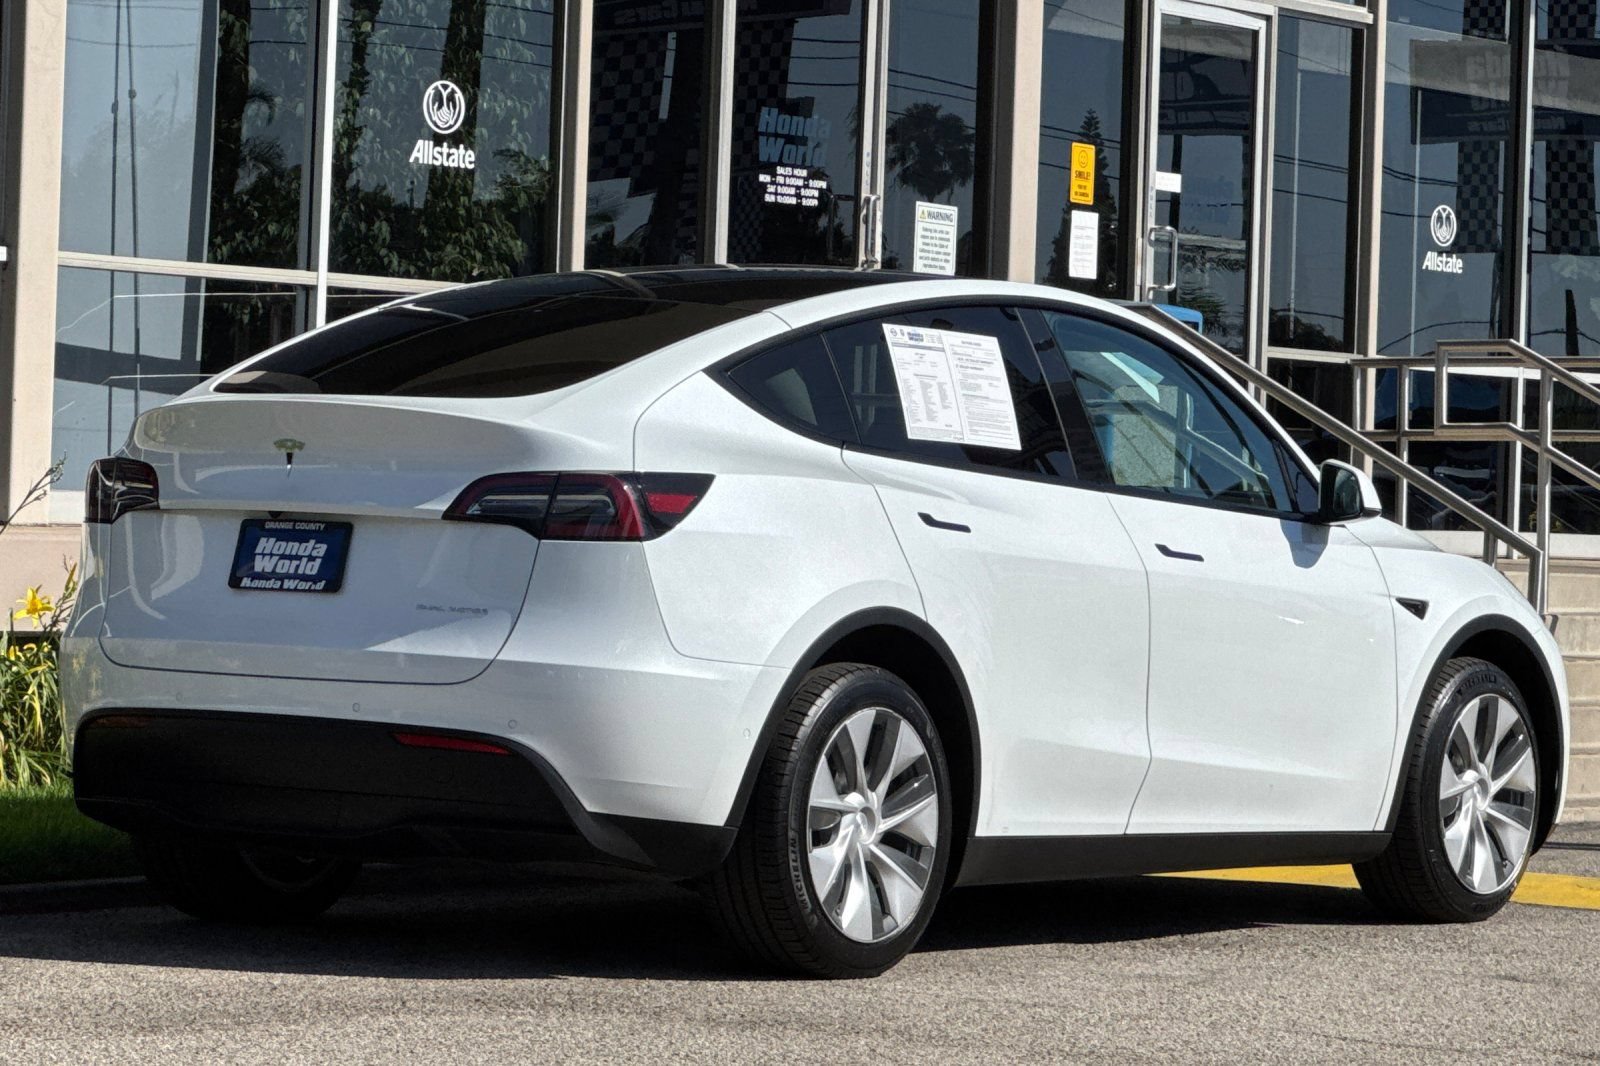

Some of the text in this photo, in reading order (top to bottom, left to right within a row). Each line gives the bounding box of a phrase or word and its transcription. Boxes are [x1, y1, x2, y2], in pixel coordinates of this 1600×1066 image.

[758, 106, 832, 139] Honda
[409, 139, 475, 169] Allstate
[759, 135, 828, 168] World
[759, 174, 771, 182] MON
[776, 175, 785, 184] FRI
[776, 166, 792, 175] SALES
[766, 184, 776, 193] SAT
[764, 193, 775, 202] SUN
[927, 208, 954, 223] WARNING
[1422, 250, 1463, 274] Allstate
[265, 521, 326, 531] ORANGE COUNTY
[254, 537, 328, 557] Honda
[254, 554, 322, 575] World
[240, 577, 282, 589] Honda
[790, 838, 807, 910] MICHELIN
